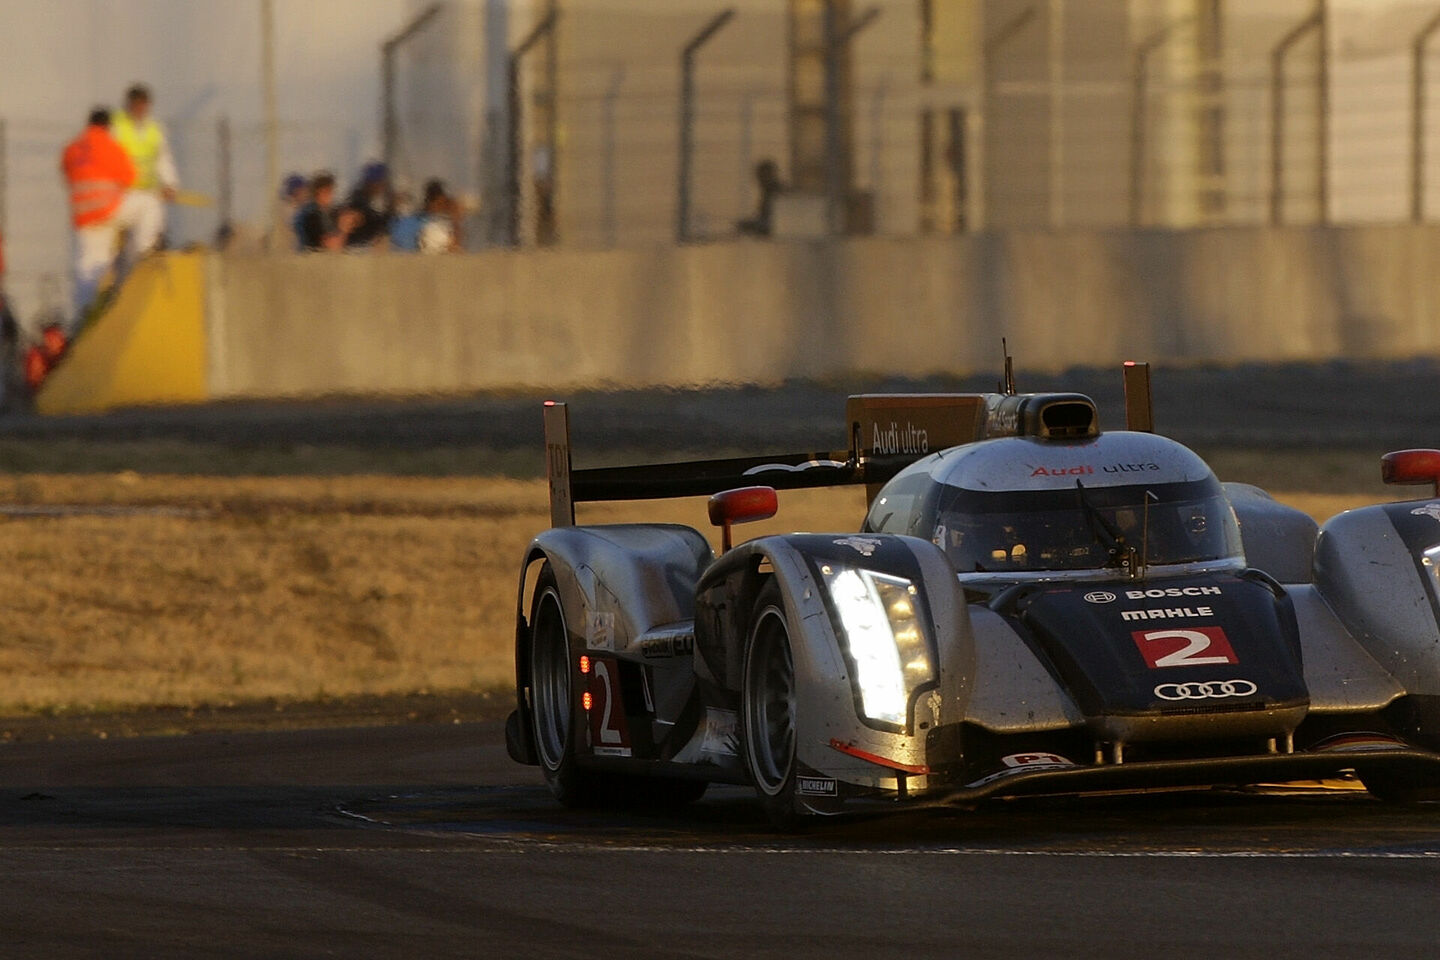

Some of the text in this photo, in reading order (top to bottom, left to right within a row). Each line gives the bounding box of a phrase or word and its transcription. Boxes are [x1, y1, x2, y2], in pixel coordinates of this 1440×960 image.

[873, 422, 929, 455] Audi ultra
[1030, 462, 1160, 477] Audi ultra
[1125, 586, 1222, 600] BOSCH
[1121, 606, 1214, 621] MAHLE
[1144, 630, 1229, 668] 2
[594, 661, 622, 744] 2
[802, 779, 835, 791] MICHELIN
